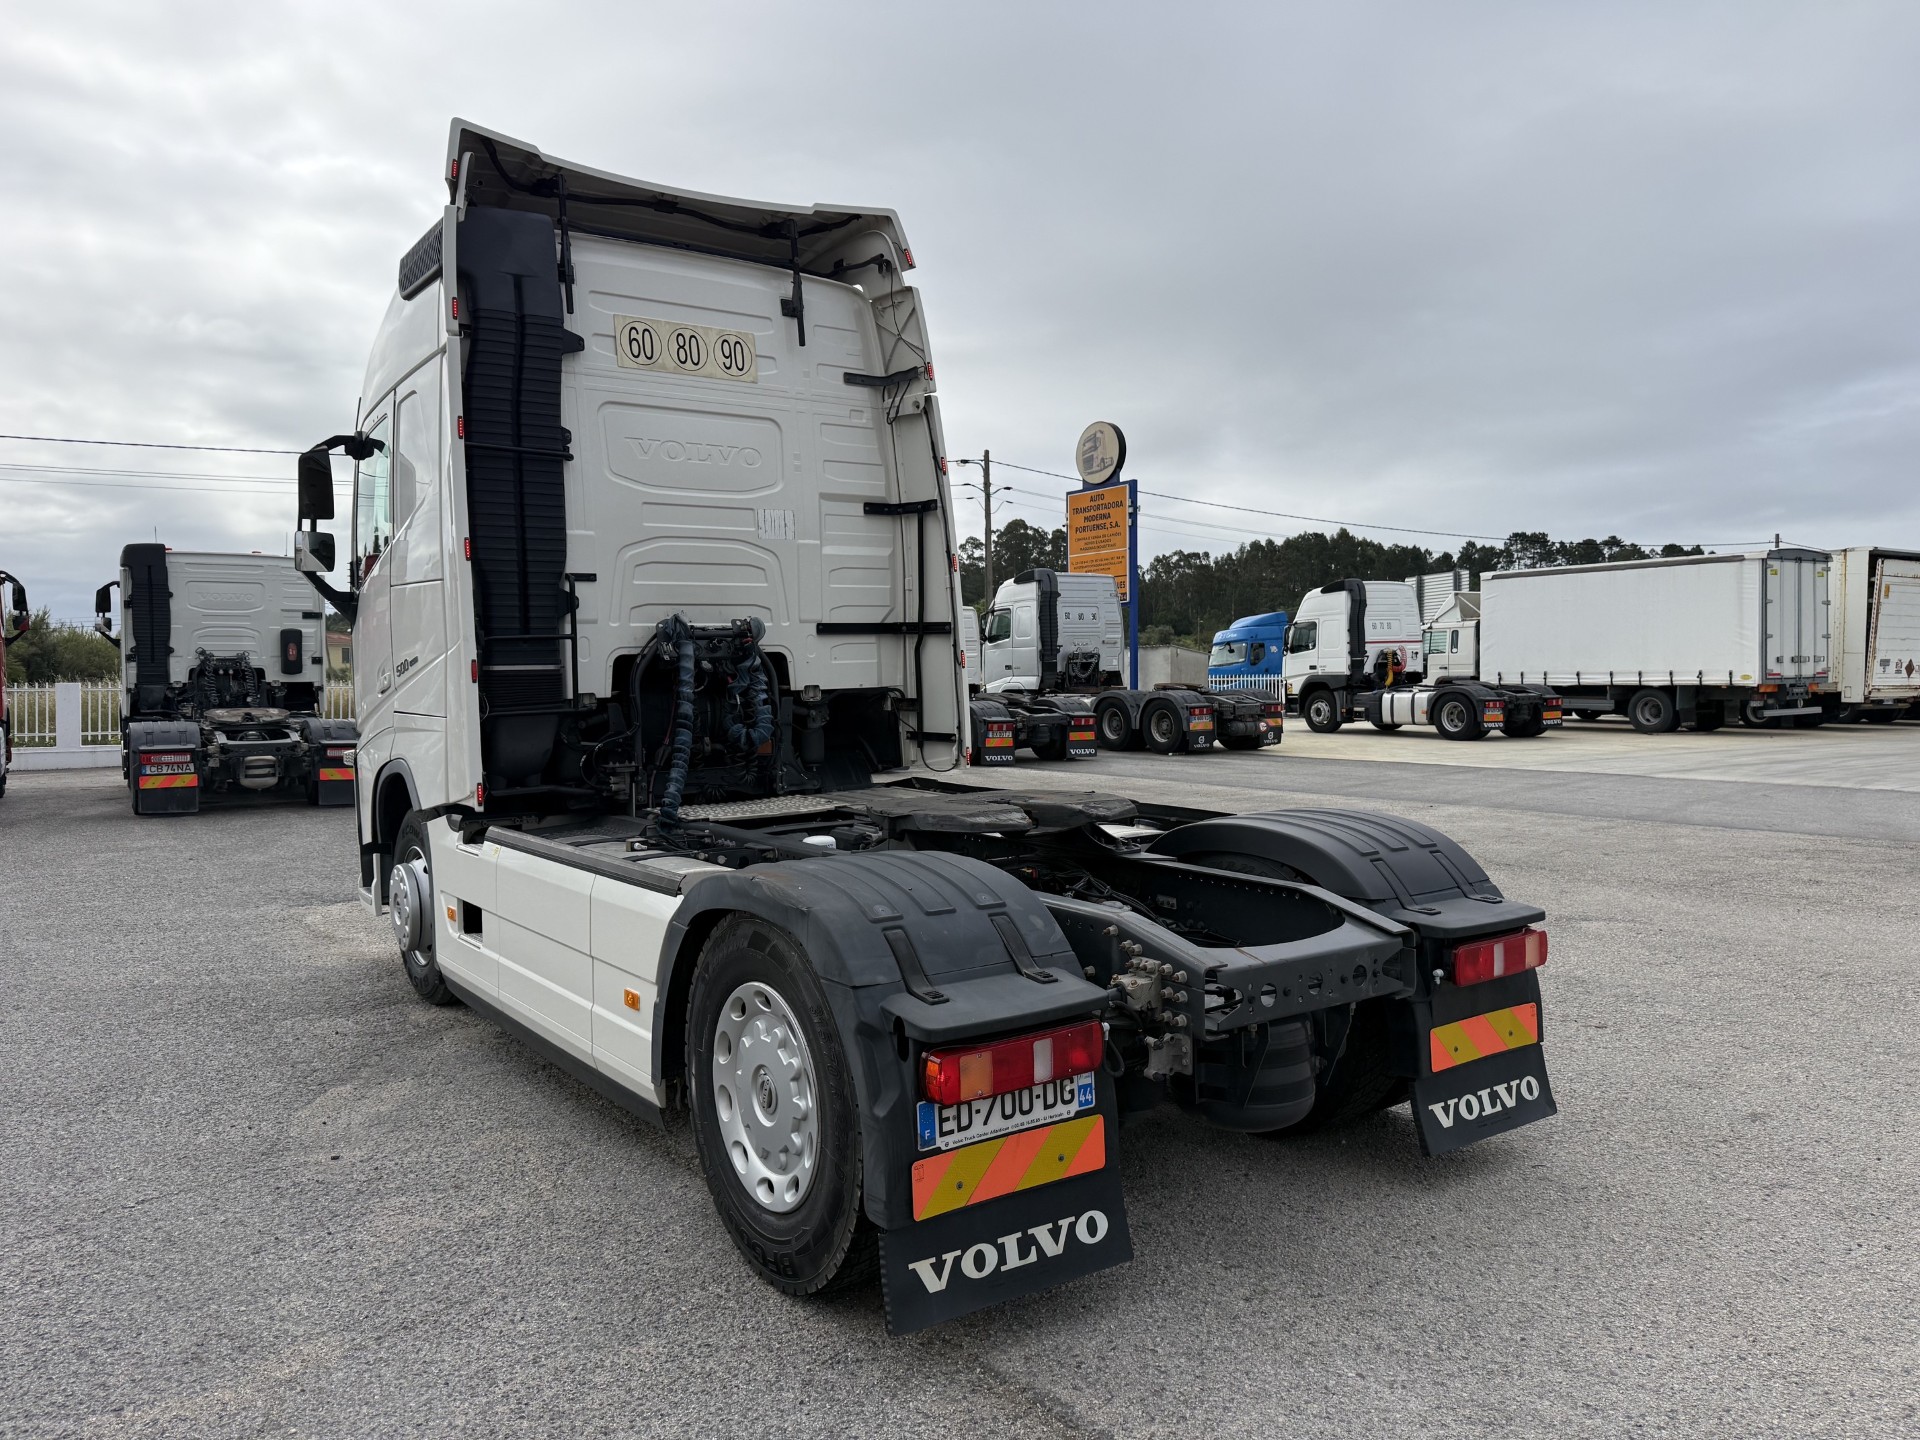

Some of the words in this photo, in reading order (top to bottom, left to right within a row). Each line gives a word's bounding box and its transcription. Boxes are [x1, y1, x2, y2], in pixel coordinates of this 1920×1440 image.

[628, 326, 654, 361] 60
[675, 332, 701, 366] 80
[720, 338, 745, 372] 90
[624, 436, 762, 469] VOLVO
[1089, 493, 1105, 503] AUTO
[1072, 500, 1124, 515] TRANSPORTADORA
[1083, 512, 1111, 523] MODERNA
[1075, 522, 1109, 534] PORTUENSE,
[1109, 521, 1121, 530] S.A.
[396, 658, 410, 678] 500
[1079, 1087, 1092, 1104] 44
[1428, 1075, 1540, 1129] VOLVO
[924, 1129, 931, 1140] F
[908, 1209, 1109, 1294] VOLVO
